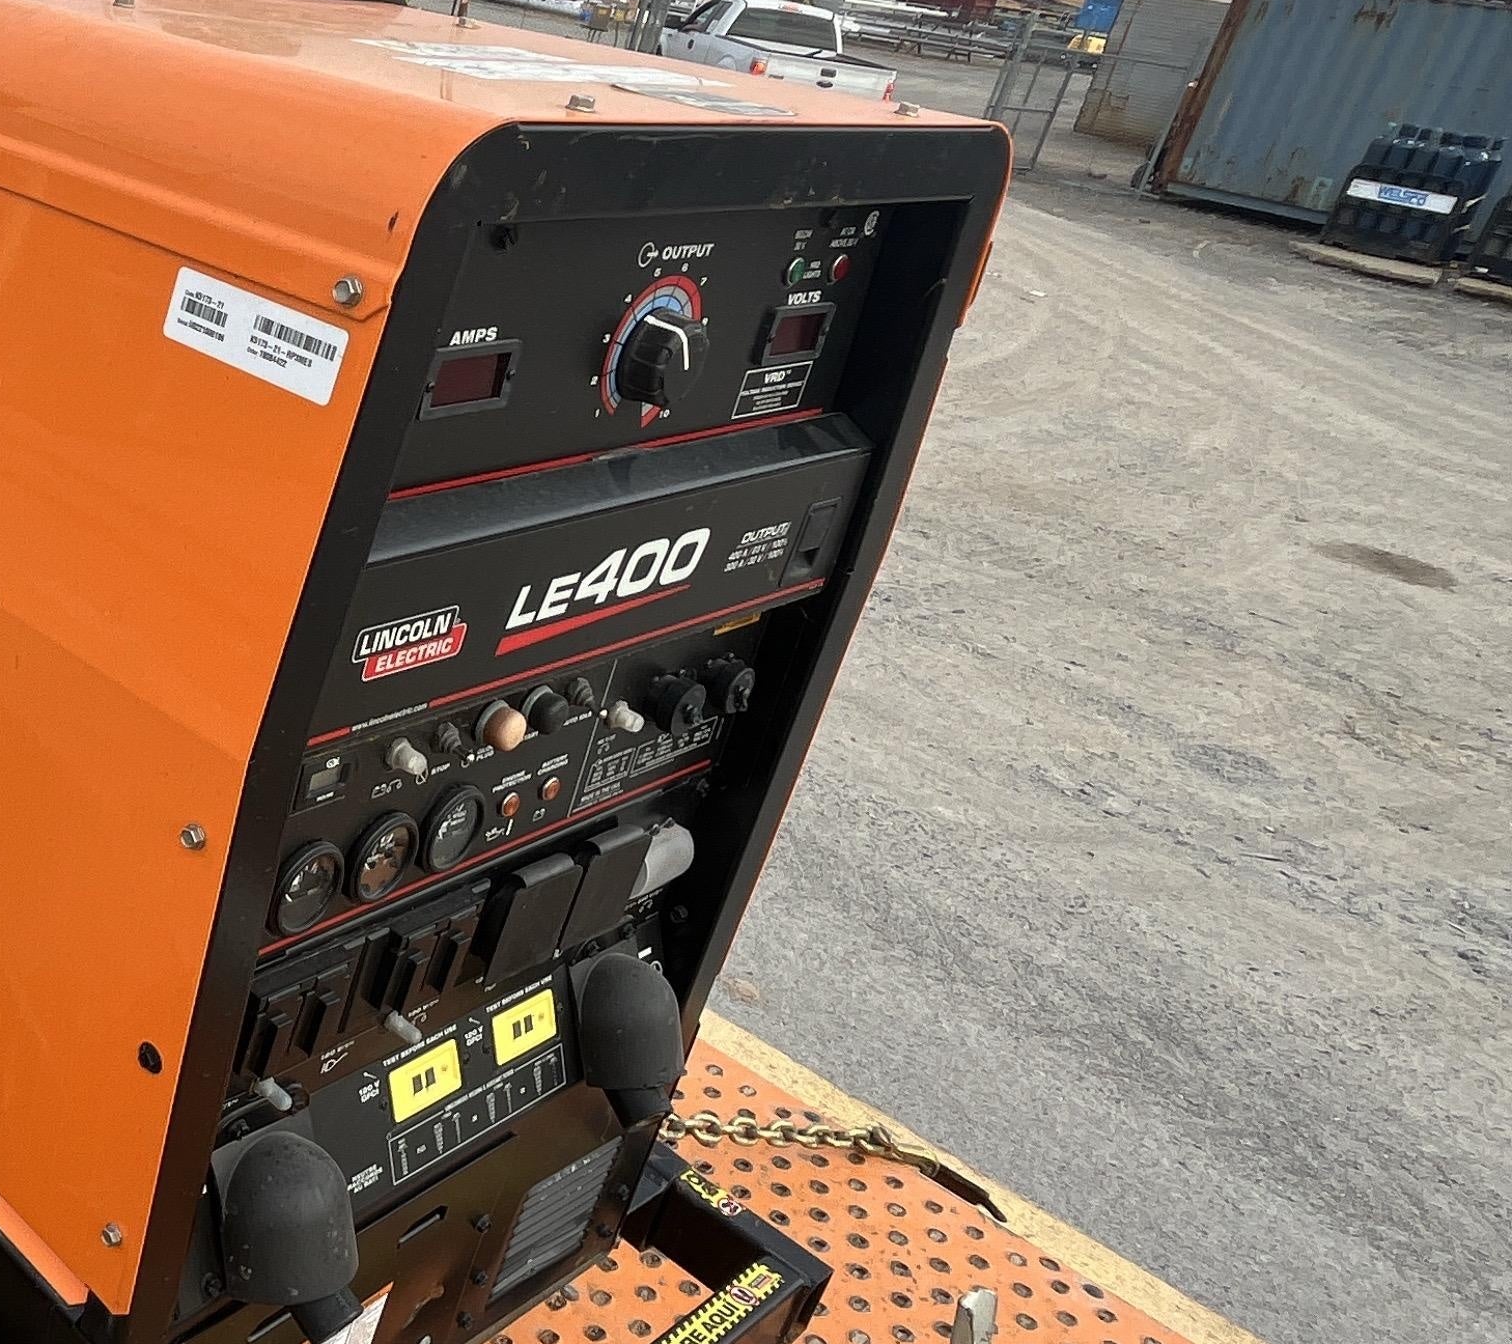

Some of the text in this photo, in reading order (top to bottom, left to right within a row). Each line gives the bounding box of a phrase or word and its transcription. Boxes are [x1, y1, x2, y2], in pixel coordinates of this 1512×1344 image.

[662, 243, 715, 261] OUTPUT
[654, 267, 662, 278] 5
[681, 263, 689, 273] 6
[700, 276, 708, 287] 7
[624, 293, 633, 304] 4
[788, 290, 822, 306] VOLTS
[449, 326, 498, 346] AMPS
[602, 333, 611, 344] 3
[590, 375, 598, 386] 2
[659, 409, 670, 419] 10
[741, 521, 792, 544] OUTPUT
[505, 525, 713, 630] LE400
[359, 613, 452, 656] LINCOLN
[375, 637, 454, 673] ELECTRIC
[486, 974, 553, 1013] TEST BEFORE EACH USE
[382, 1024, 458, 1067] TEST BEFORE EACH USE
